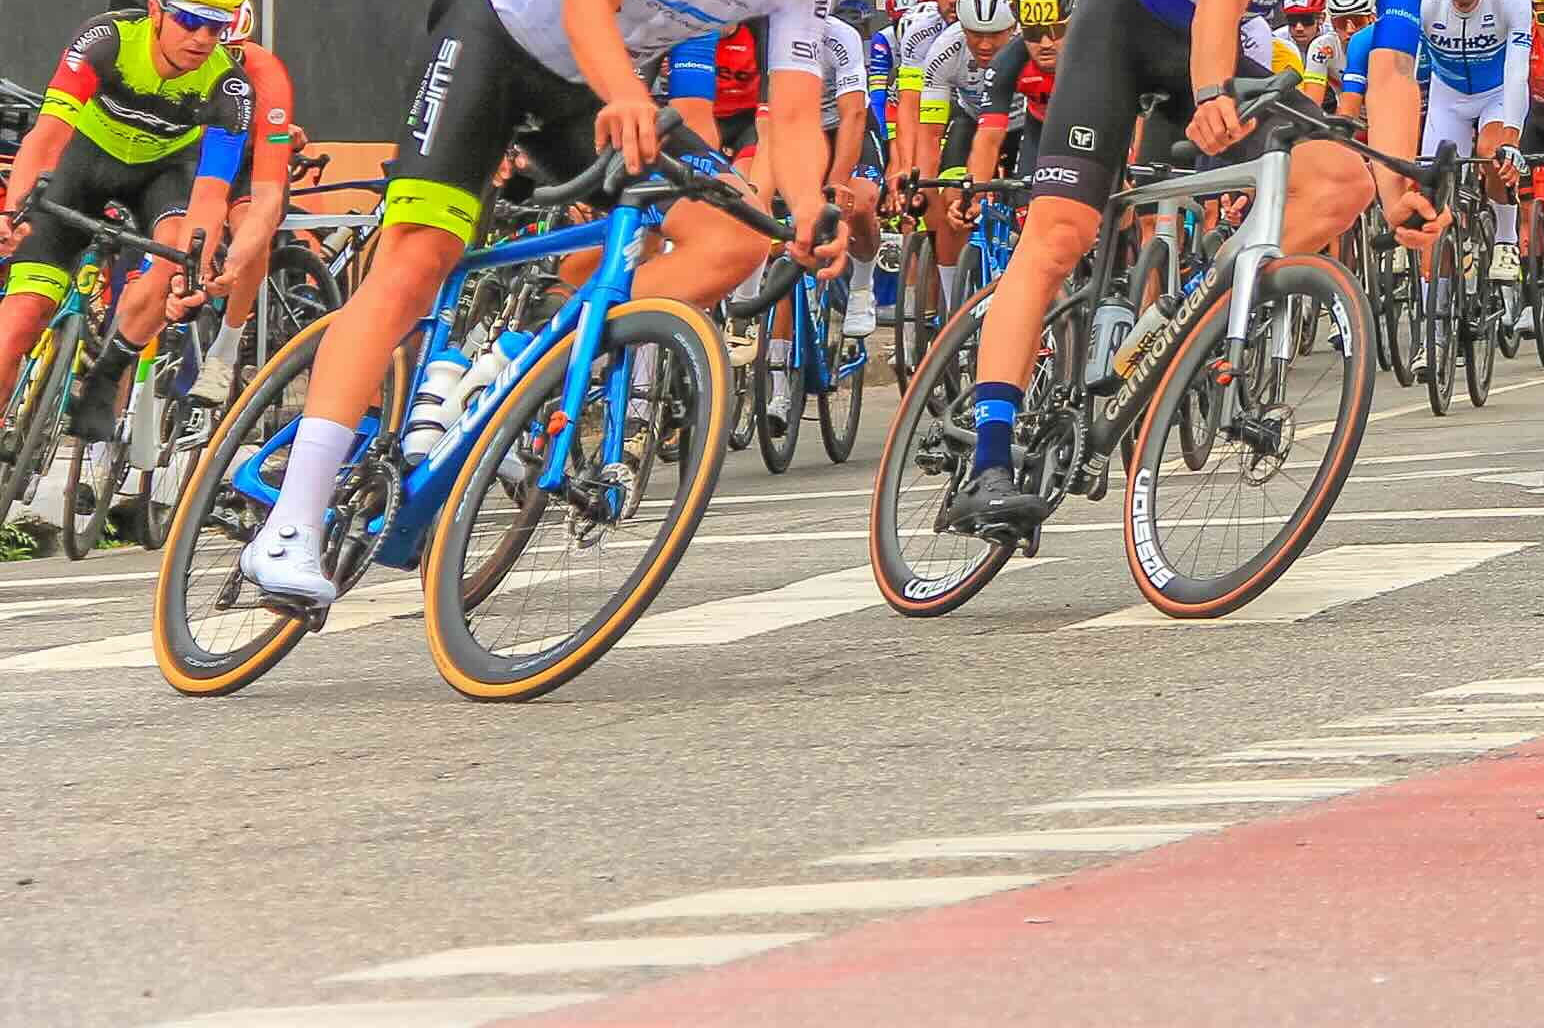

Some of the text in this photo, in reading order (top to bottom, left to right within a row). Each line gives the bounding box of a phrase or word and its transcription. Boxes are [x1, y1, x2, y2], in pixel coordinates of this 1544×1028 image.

[1023, 3, 1054, 22] 202
[74, 25, 113, 52] MASOTTI
[905, 22, 943, 60] SHIMANO
[411, 37, 460, 156] SWIFT
[1105, 267, 1217, 422] cannondale
